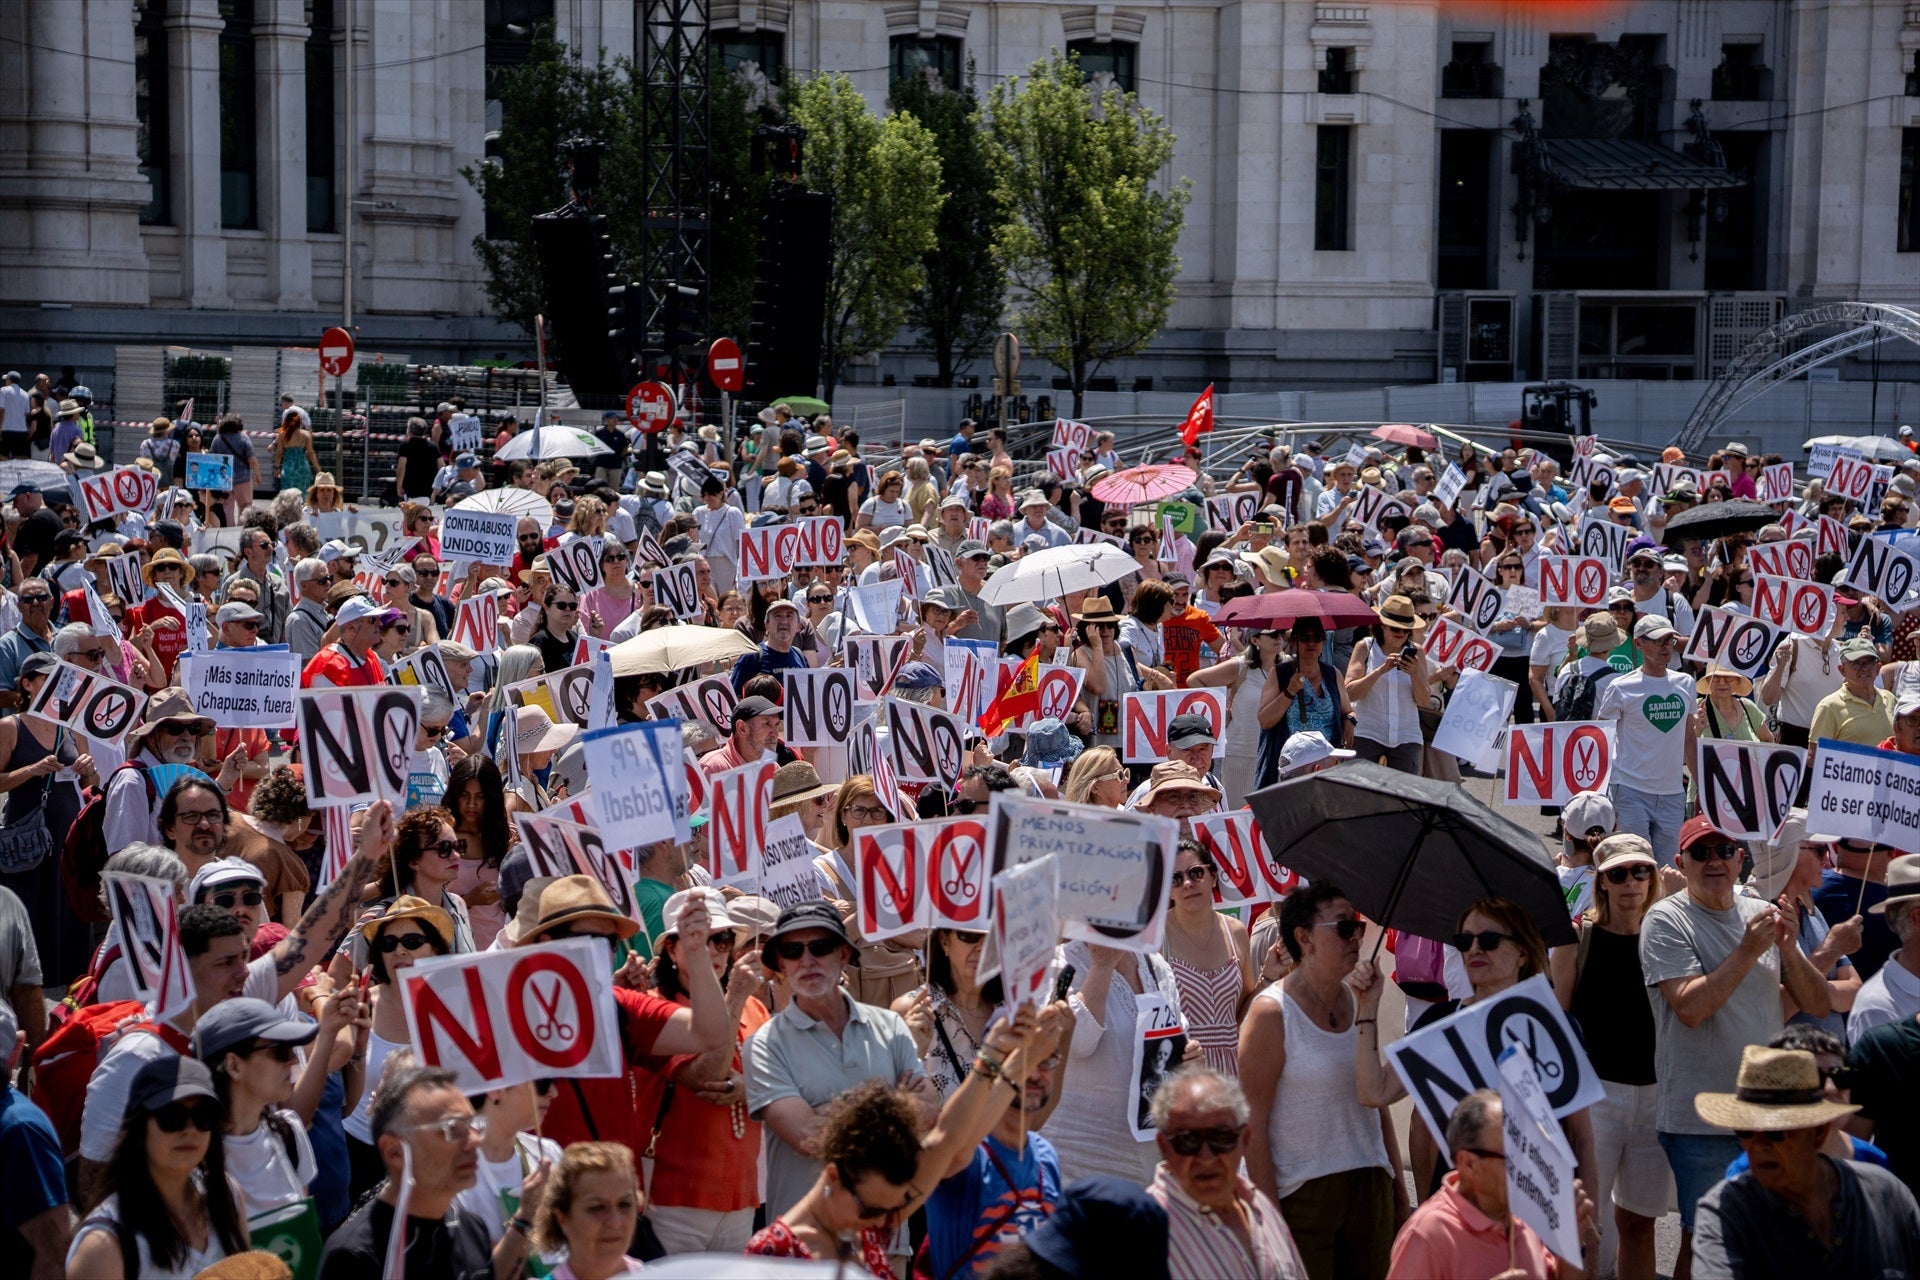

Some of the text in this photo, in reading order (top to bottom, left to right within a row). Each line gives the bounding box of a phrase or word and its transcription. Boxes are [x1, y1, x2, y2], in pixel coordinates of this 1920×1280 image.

[1054, 420, 1087, 448] NO
[1575, 436, 1594, 456] NO
[1049, 449, 1080, 480] NO
[1765, 465, 1792, 500] NO
[1809, 459, 1831, 471] Centros
[1826, 457, 1872, 498] NO
[81, 470, 143, 518] NO
[1206, 494, 1257, 531] NO
[443, 537, 510, 557] UNIDOS, YA!
[445, 516, 512, 537] CONTRA ABUSOS,
[797, 518, 841, 562] NO
[546, 542, 598, 593] NO
[741, 526, 799, 577] NO
[1750, 541, 1810, 579] NO
[1851, 538, 1913, 604] NO
[108, 555, 143, 604] NO
[656, 566, 697, 615] NO
[1450, 567, 1501, 629] NO
[1540, 558, 1607, 604] NO
[454, 594, 497, 651] NO
[1753, 577, 1827, 633] NO
[1424, 619, 1493, 671] NO
[1687, 609, 1770, 670] NO
[32, 664, 136, 738] NO
[204, 665, 294, 688] ¡Más sanitarios!
[197, 690, 295, 715] ¡Chapuzas, fuera!
[787, 673, 851, 742] NO
[1127, 691, 1221, 758] NO
[1648, 701, 1681, 711] SANIDAD
[1649, 710, 1681, 721] PÚBLICA
[302, 691, 418, 798] NO
[889, 702, 962, 788] NO
[1508, 725, 1608, 799] NO
[1703, 745, 1801, 832] NO
[1823, 756, 1881, 786] Estamos
[712, 763, 775, 879] NO
[1021, 817, 1085, 835] MENOS
[1821, 790, 1837, 813] de
[1845, 794, 1864, 816] ser
[520, 820, 631, 917] NO
[859, 822, 987, 934] NO
[407, 952, 594, 1080] NO
[1397, 996, 1578, 1130] NO
